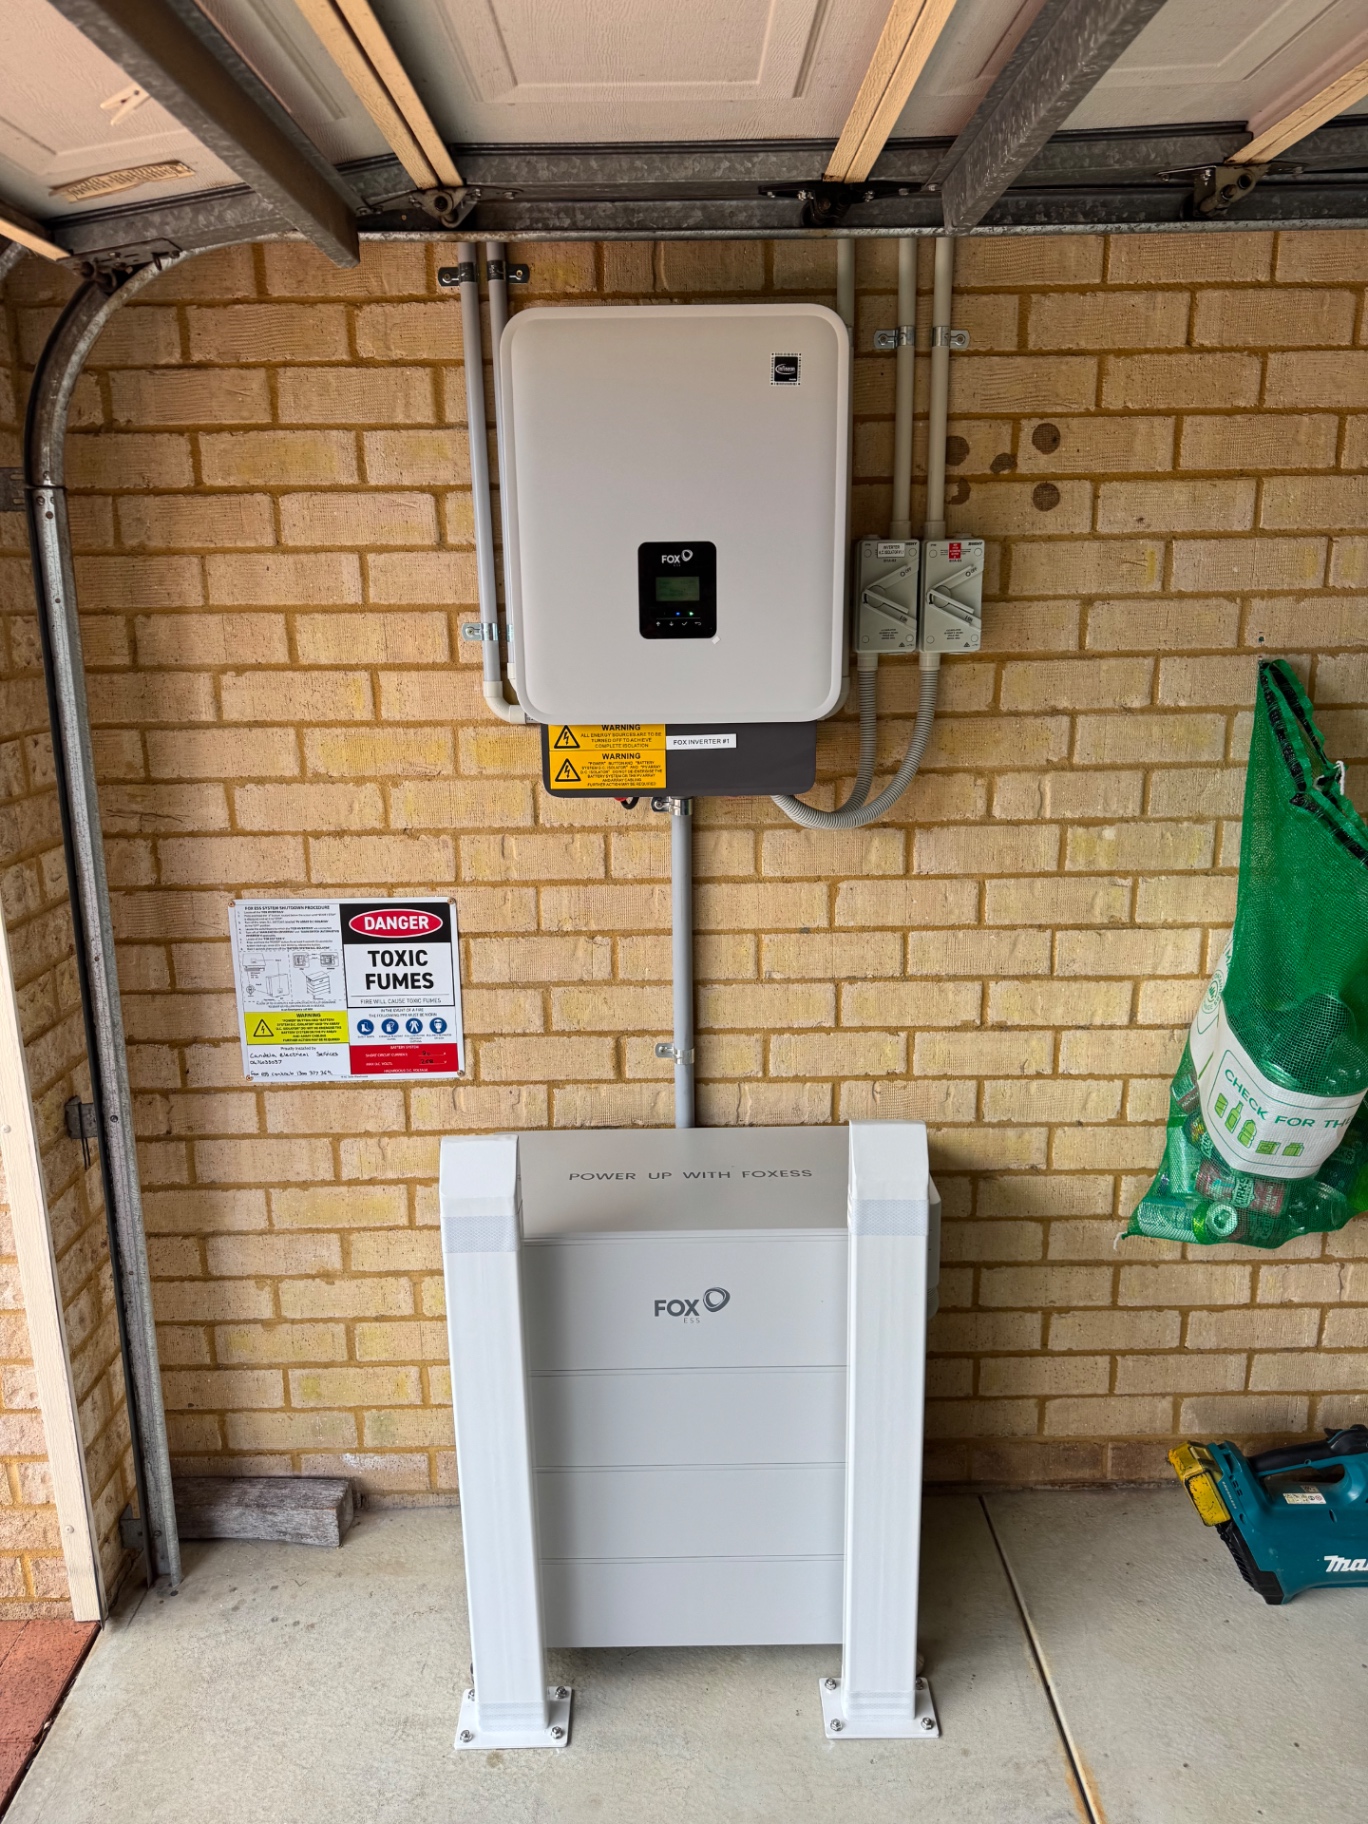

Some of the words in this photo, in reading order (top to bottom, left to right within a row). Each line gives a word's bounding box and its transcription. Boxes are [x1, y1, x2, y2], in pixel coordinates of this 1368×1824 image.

[661, 555, 681, 564] FOX
[364, 916, 429, 930] DANGER
[367, 950, 428, 967] TOXIC
[365, 972, 434, 990] FUMES
[1224, 1069, 1268, 1120] CHECK
[1274, 1115, 1315, 1127] FOR
[569, 1172, 637, 1181] POWER
[648, 1172, 673, 1180] UP
[683, 1171, 731, 1179] WITH
[742, 1170, 813, 1178] FOXESS
[654, 1299, 700, 1317] FOX
